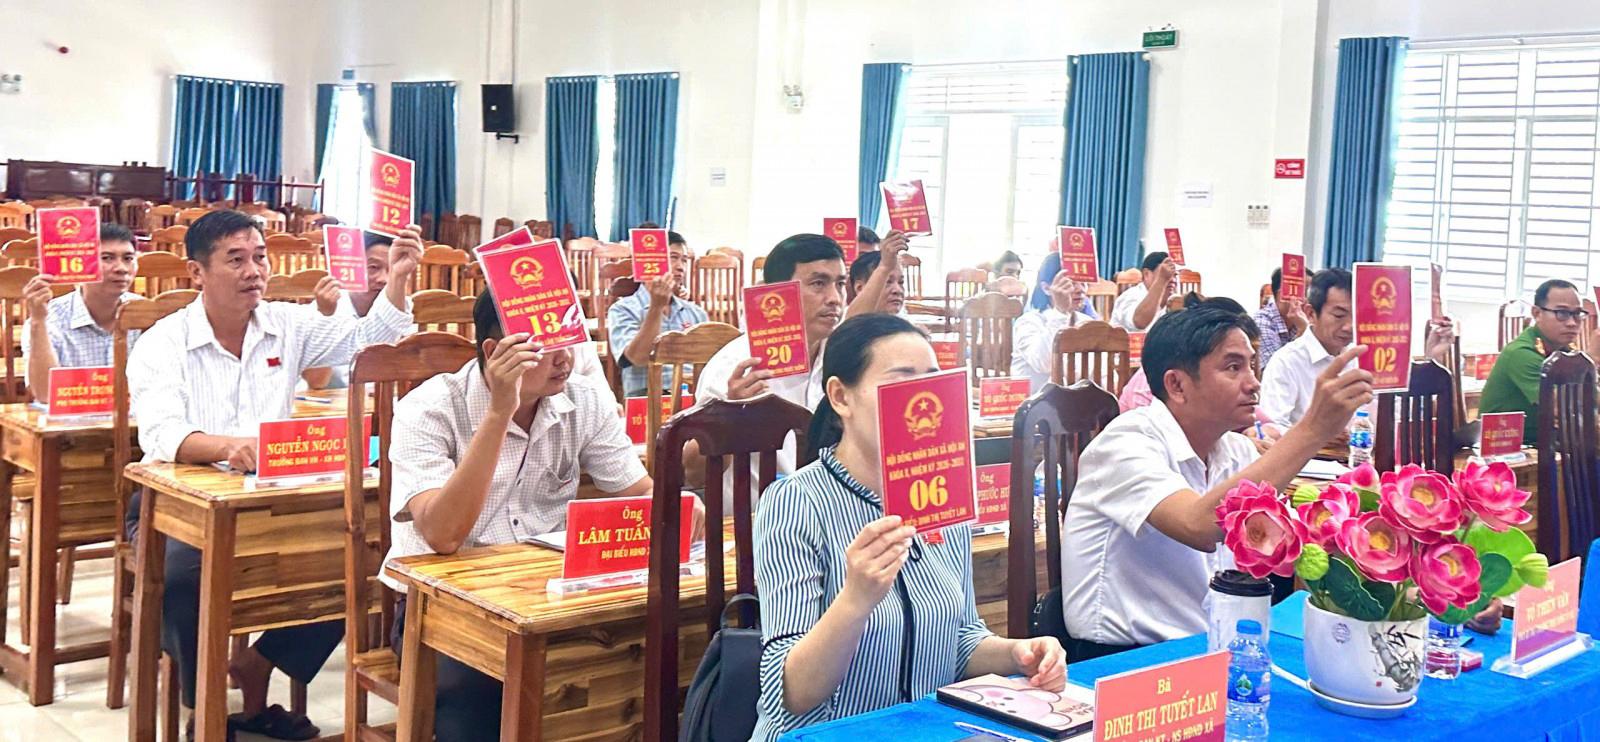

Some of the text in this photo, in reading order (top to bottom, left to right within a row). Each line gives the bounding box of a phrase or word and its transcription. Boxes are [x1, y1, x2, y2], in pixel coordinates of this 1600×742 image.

[383, 205, 400, 225] 12
[902, 217, 920, 231] 17
[60, 257, 84, 273] 16
[340, 267, 355, 282] 21
[643, 262, 660, 274] 25
[1288, 284, 1298, 296] 11
[528, 312, 562, 337] 13
[766, 344, 792, 367] 20
[1374, 346, 1397, 373] 02
[307, 423, 326, 437] Ông
[266, 435, 310, 456] NGUYỄN
[311, 438, 340, 453] NGỌC
[980, 471, 995, 485] Ông
[909, 474, 948, 511] 06
[622, 505, 644, 521] Ông
[578, 521, 652, 545] LÂM TUẤN
[1157, 676, 1172, 695] Bà
[1103, 690, 1219, 741] ĐINH THỊ TUYẾT LAN
